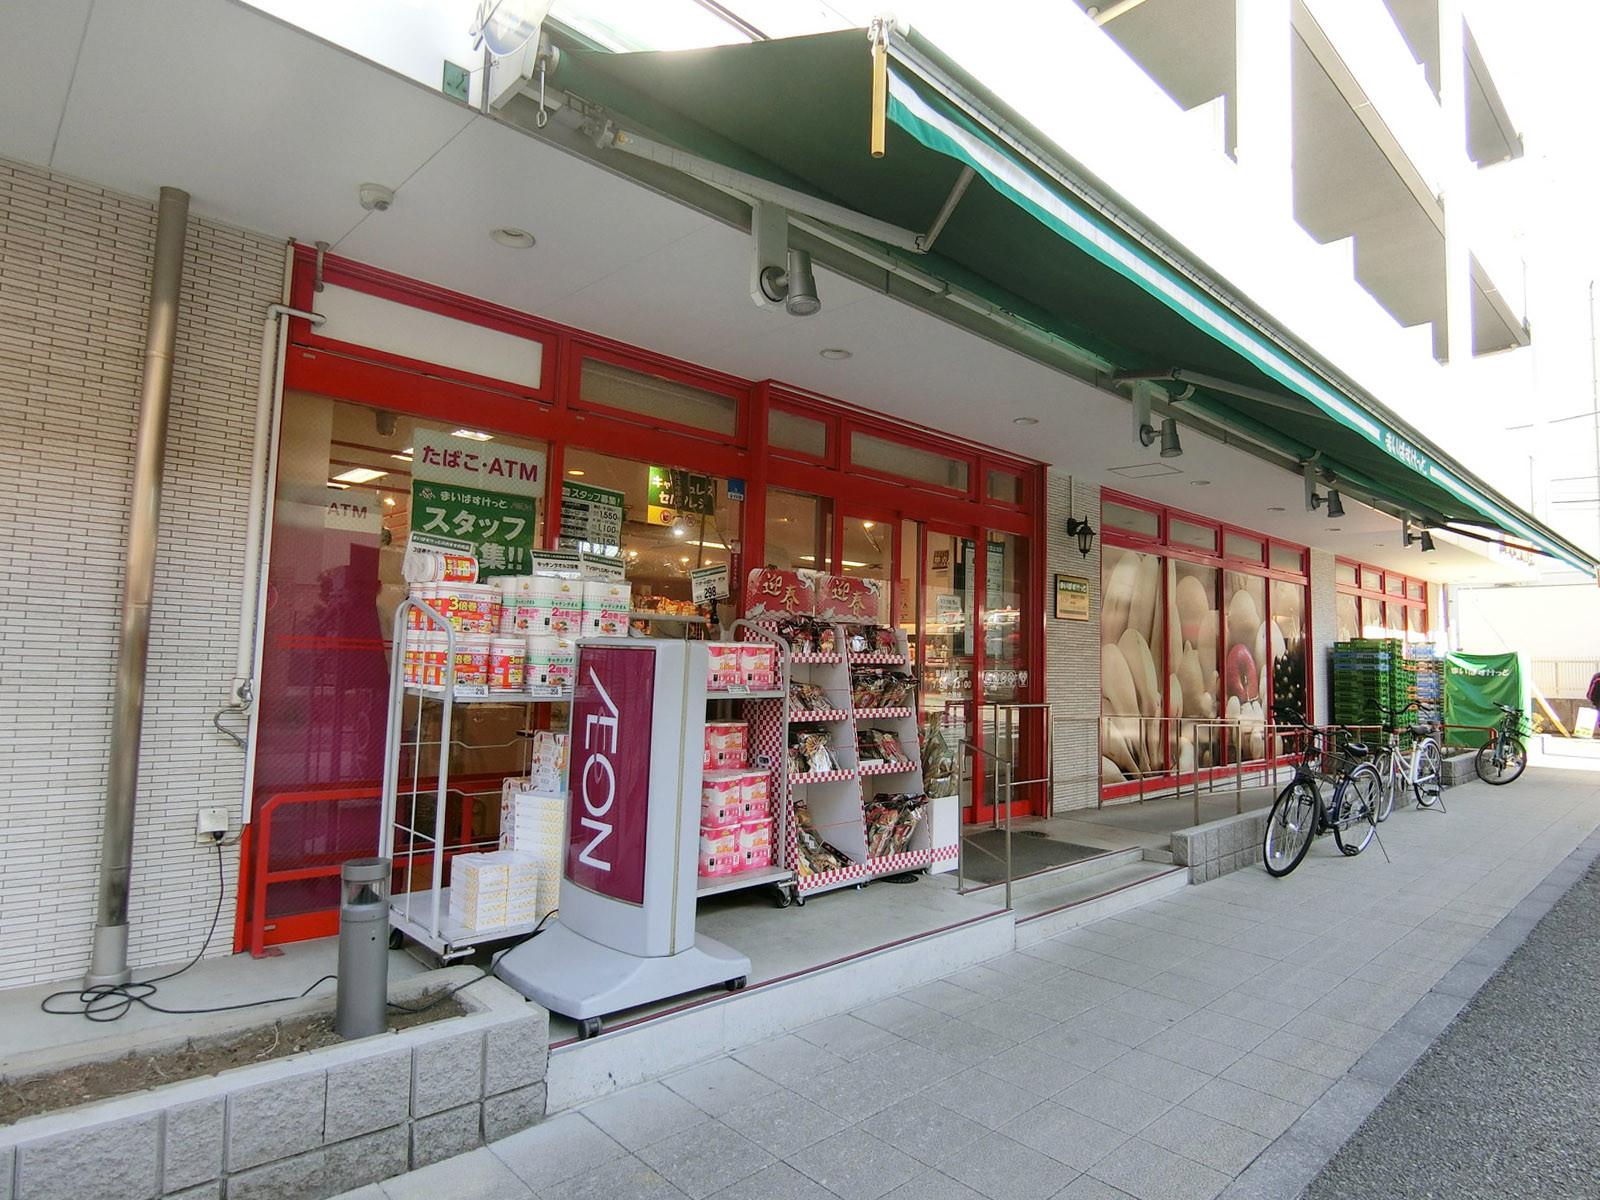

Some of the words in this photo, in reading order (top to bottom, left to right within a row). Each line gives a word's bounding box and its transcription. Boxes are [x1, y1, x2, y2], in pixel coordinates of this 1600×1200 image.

[422, 446, 539, 482] たばこ・ATM
[440, 491, 508, 509] まいばすけっと
[422, 506, 526, 541] スタッフ
[448, 596, 477, 612] 3倍巻
[703, 586, 717, 599] 298
[762, 573, 800, 614] 迎春
[832, 580, 866, 617] 迎春
[1451, 666, 1510, 677] まいばすけっと
[578, 665, 620, 872] AEON
